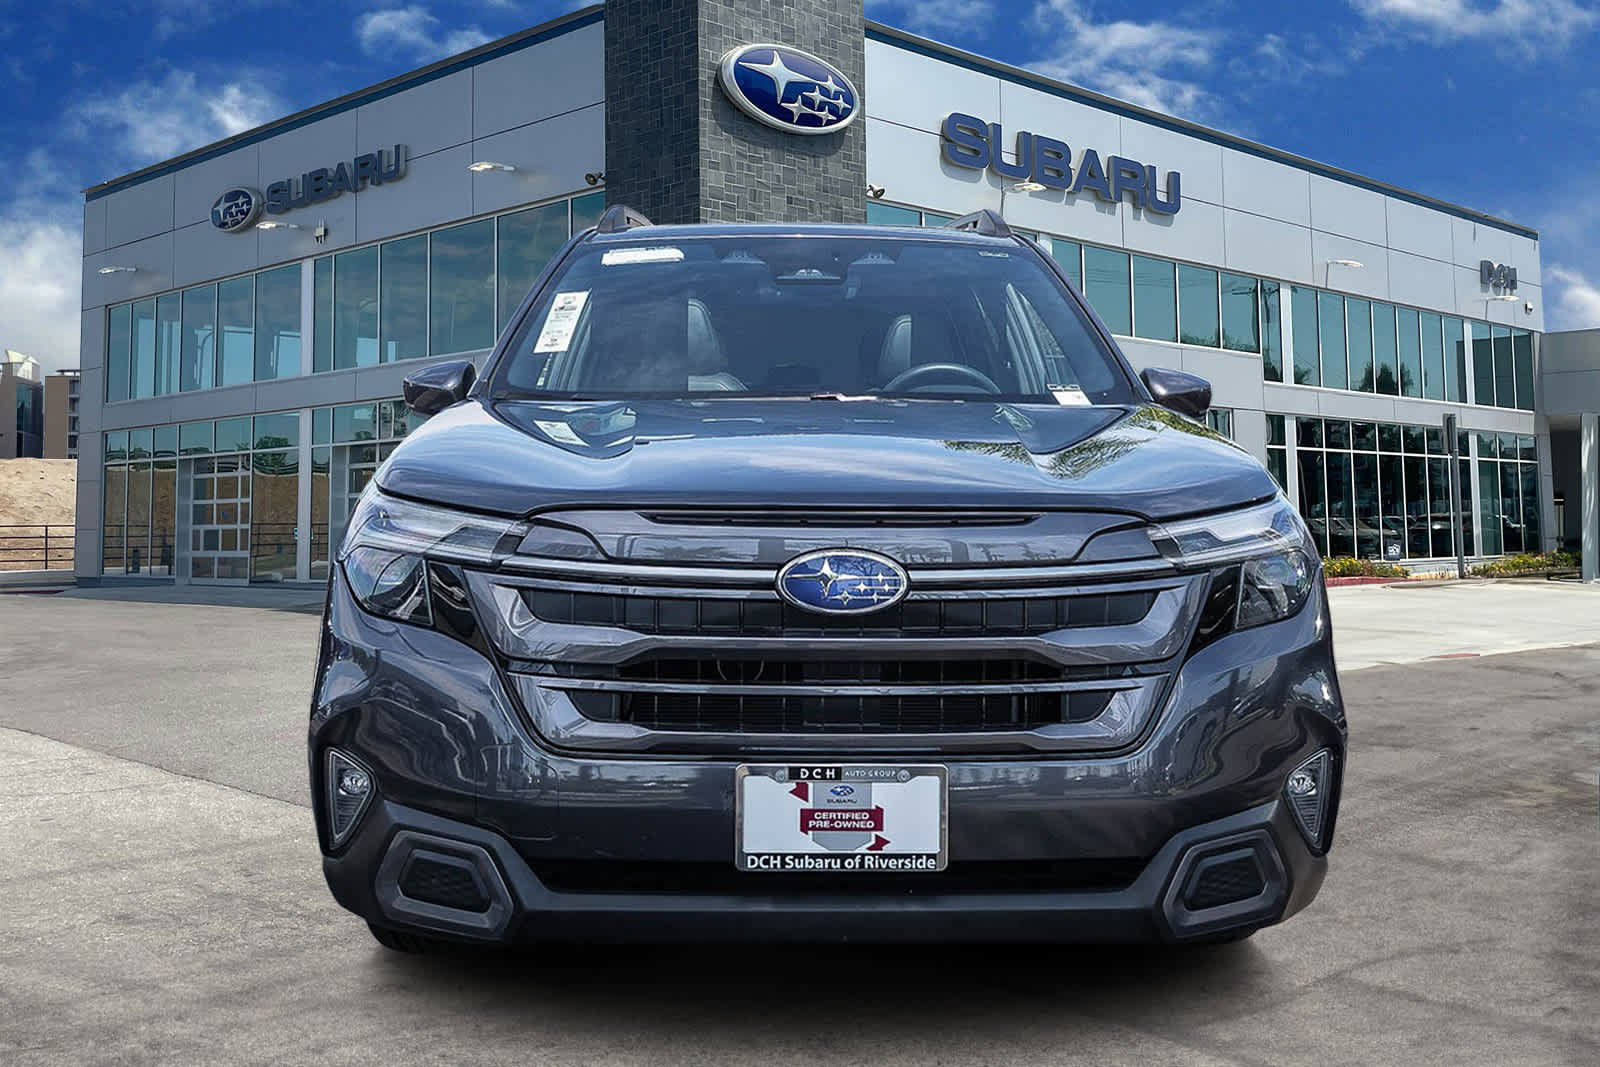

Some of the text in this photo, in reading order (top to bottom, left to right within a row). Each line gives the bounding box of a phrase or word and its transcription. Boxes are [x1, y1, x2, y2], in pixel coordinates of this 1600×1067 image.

[941, 112, 1181, 215] SUBARU
[266, 143, 406, 214] SUBARU
[800, 768, 895, 779] DCH AUTO GROUP
[814, 812, 869, 820] CERTIFIED
[808, 820, 875, 828] PRE-OWNED
[747, 855, 937, 869] DCH Subaru of Riverside
